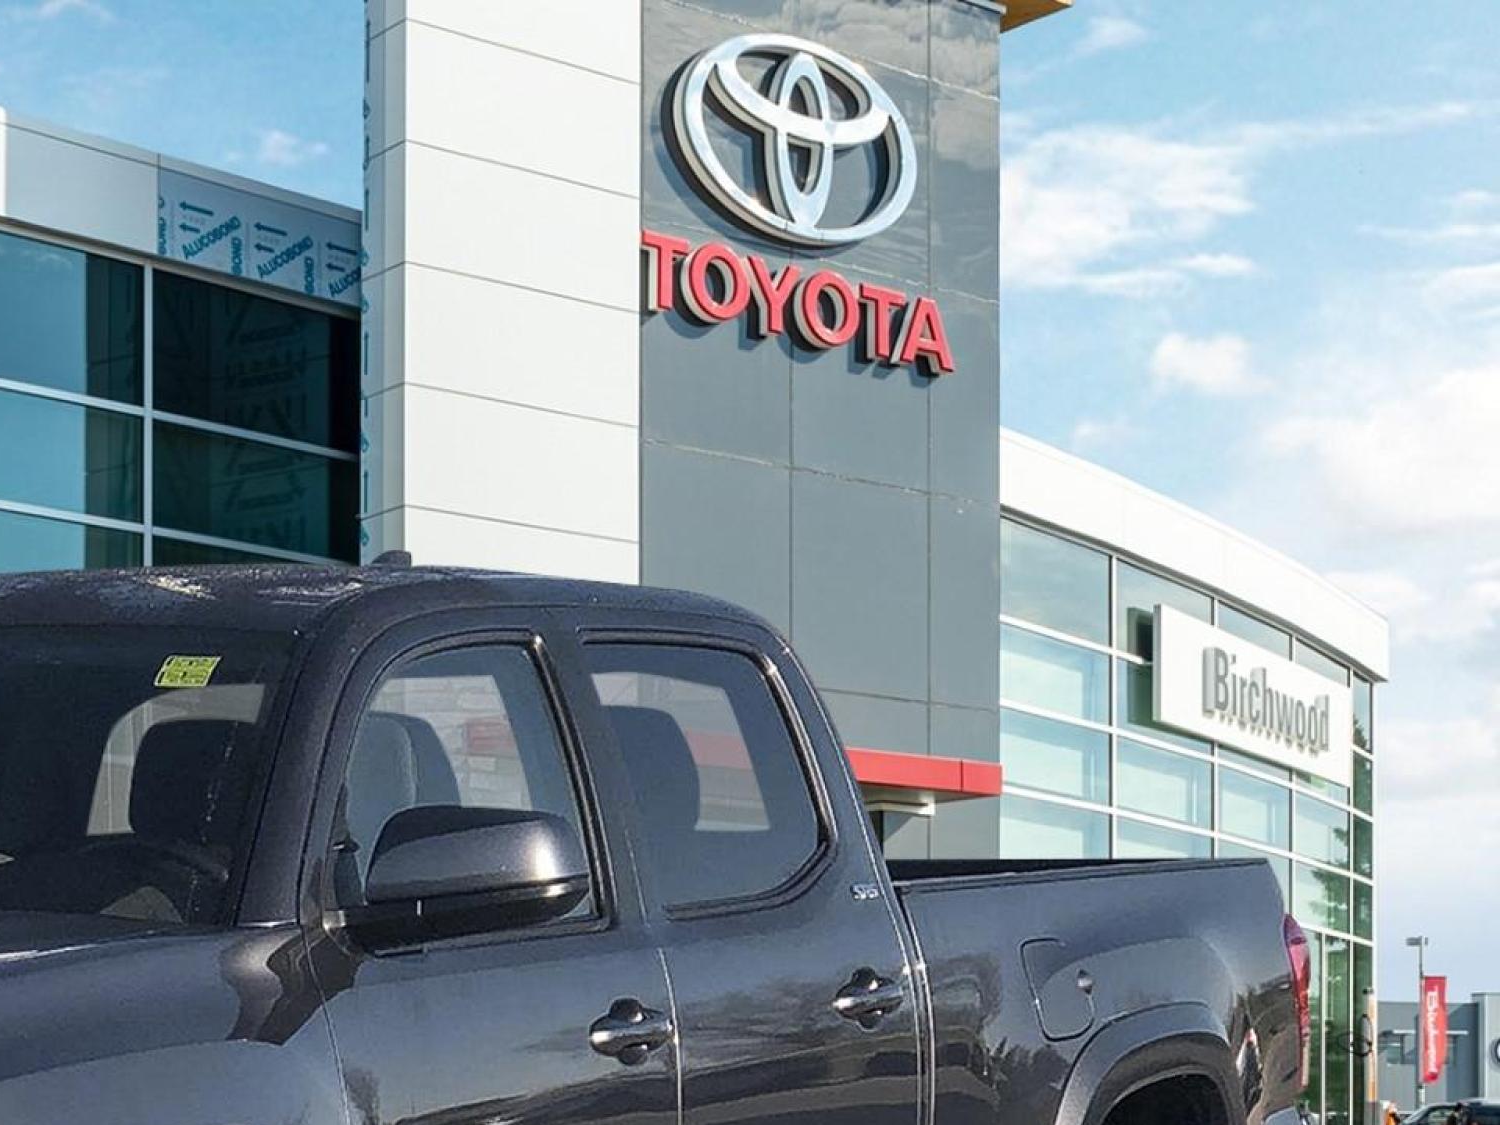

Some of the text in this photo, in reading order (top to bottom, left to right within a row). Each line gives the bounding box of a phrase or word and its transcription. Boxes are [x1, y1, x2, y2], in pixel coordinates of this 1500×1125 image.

[182, 215, 242, 260] ALUCOBOND
[256, 235, 314, 279] ALUCOBOND
[641, 230, 955, 373] TOYOTA
[1203, 647, 1330, 752] Birchwood
